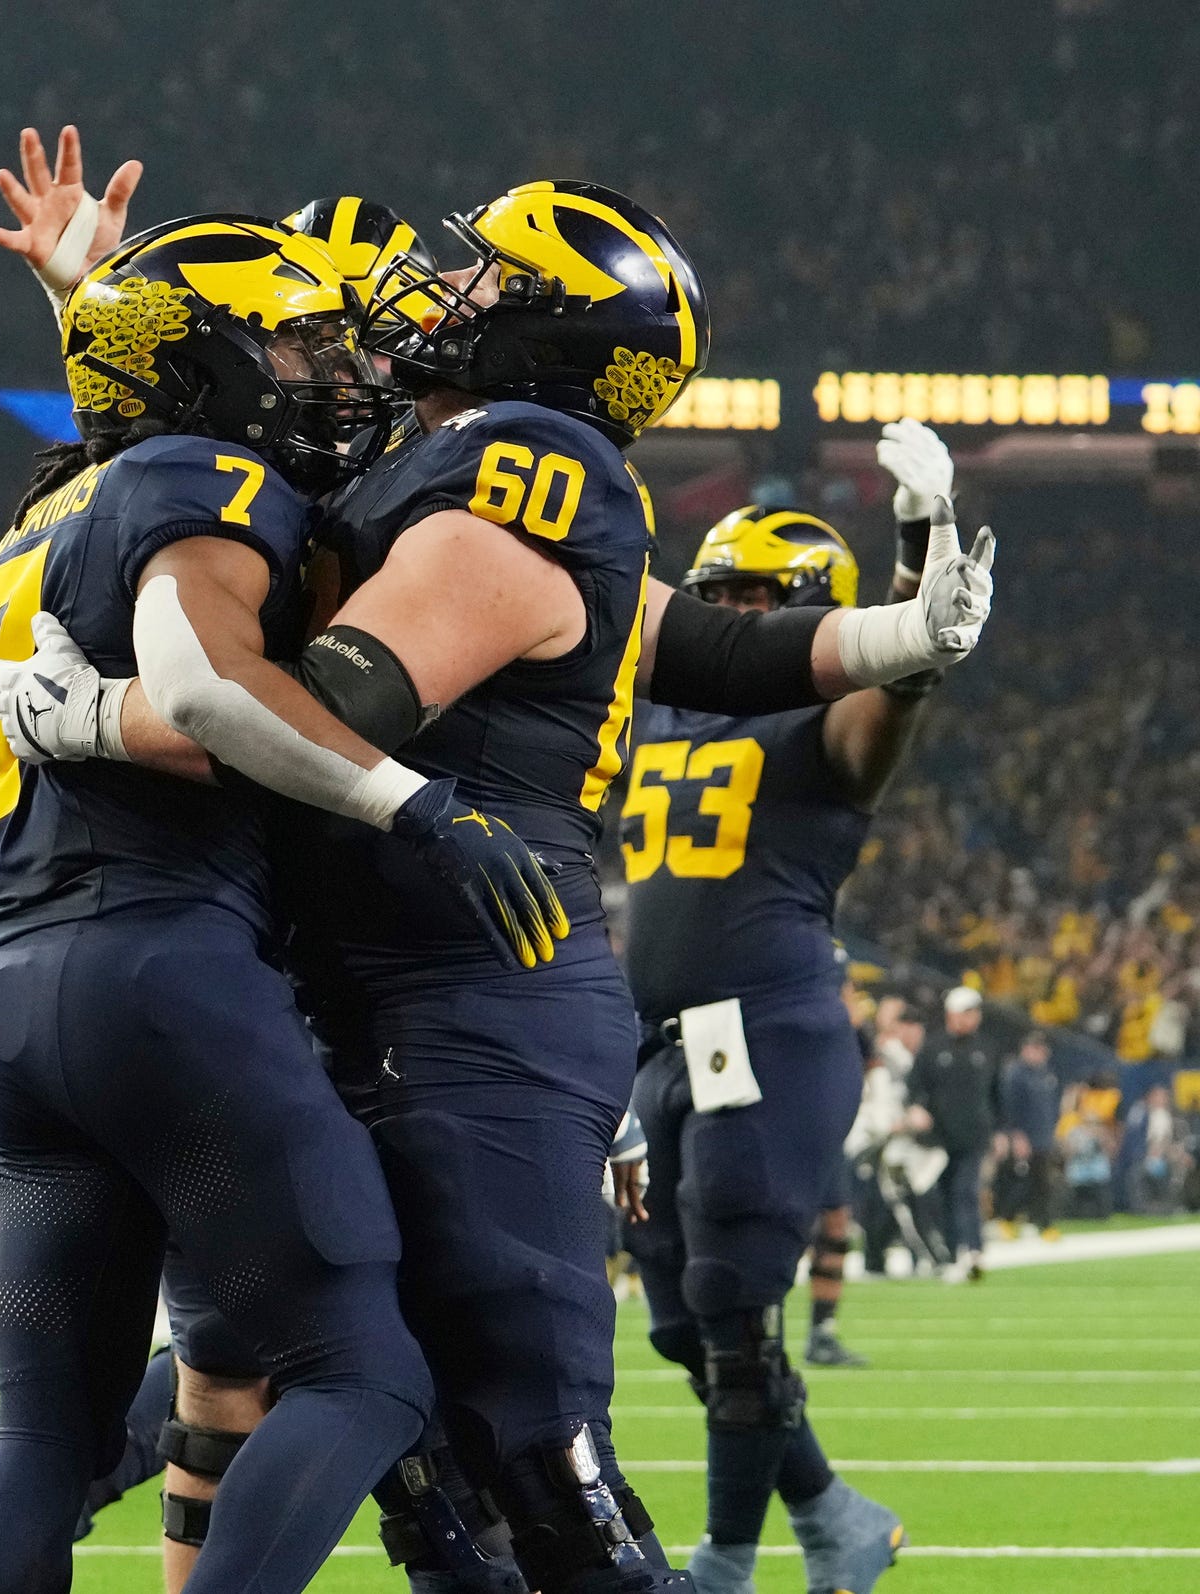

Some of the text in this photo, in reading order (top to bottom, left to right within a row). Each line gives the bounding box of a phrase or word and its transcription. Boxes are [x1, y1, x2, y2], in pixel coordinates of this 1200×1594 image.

[215, 454, 266, 526] 7
[467, 441, 586, 543] 60
[308, 634, 373, 671] Mueller
[620, 737, 764, 884] 53
